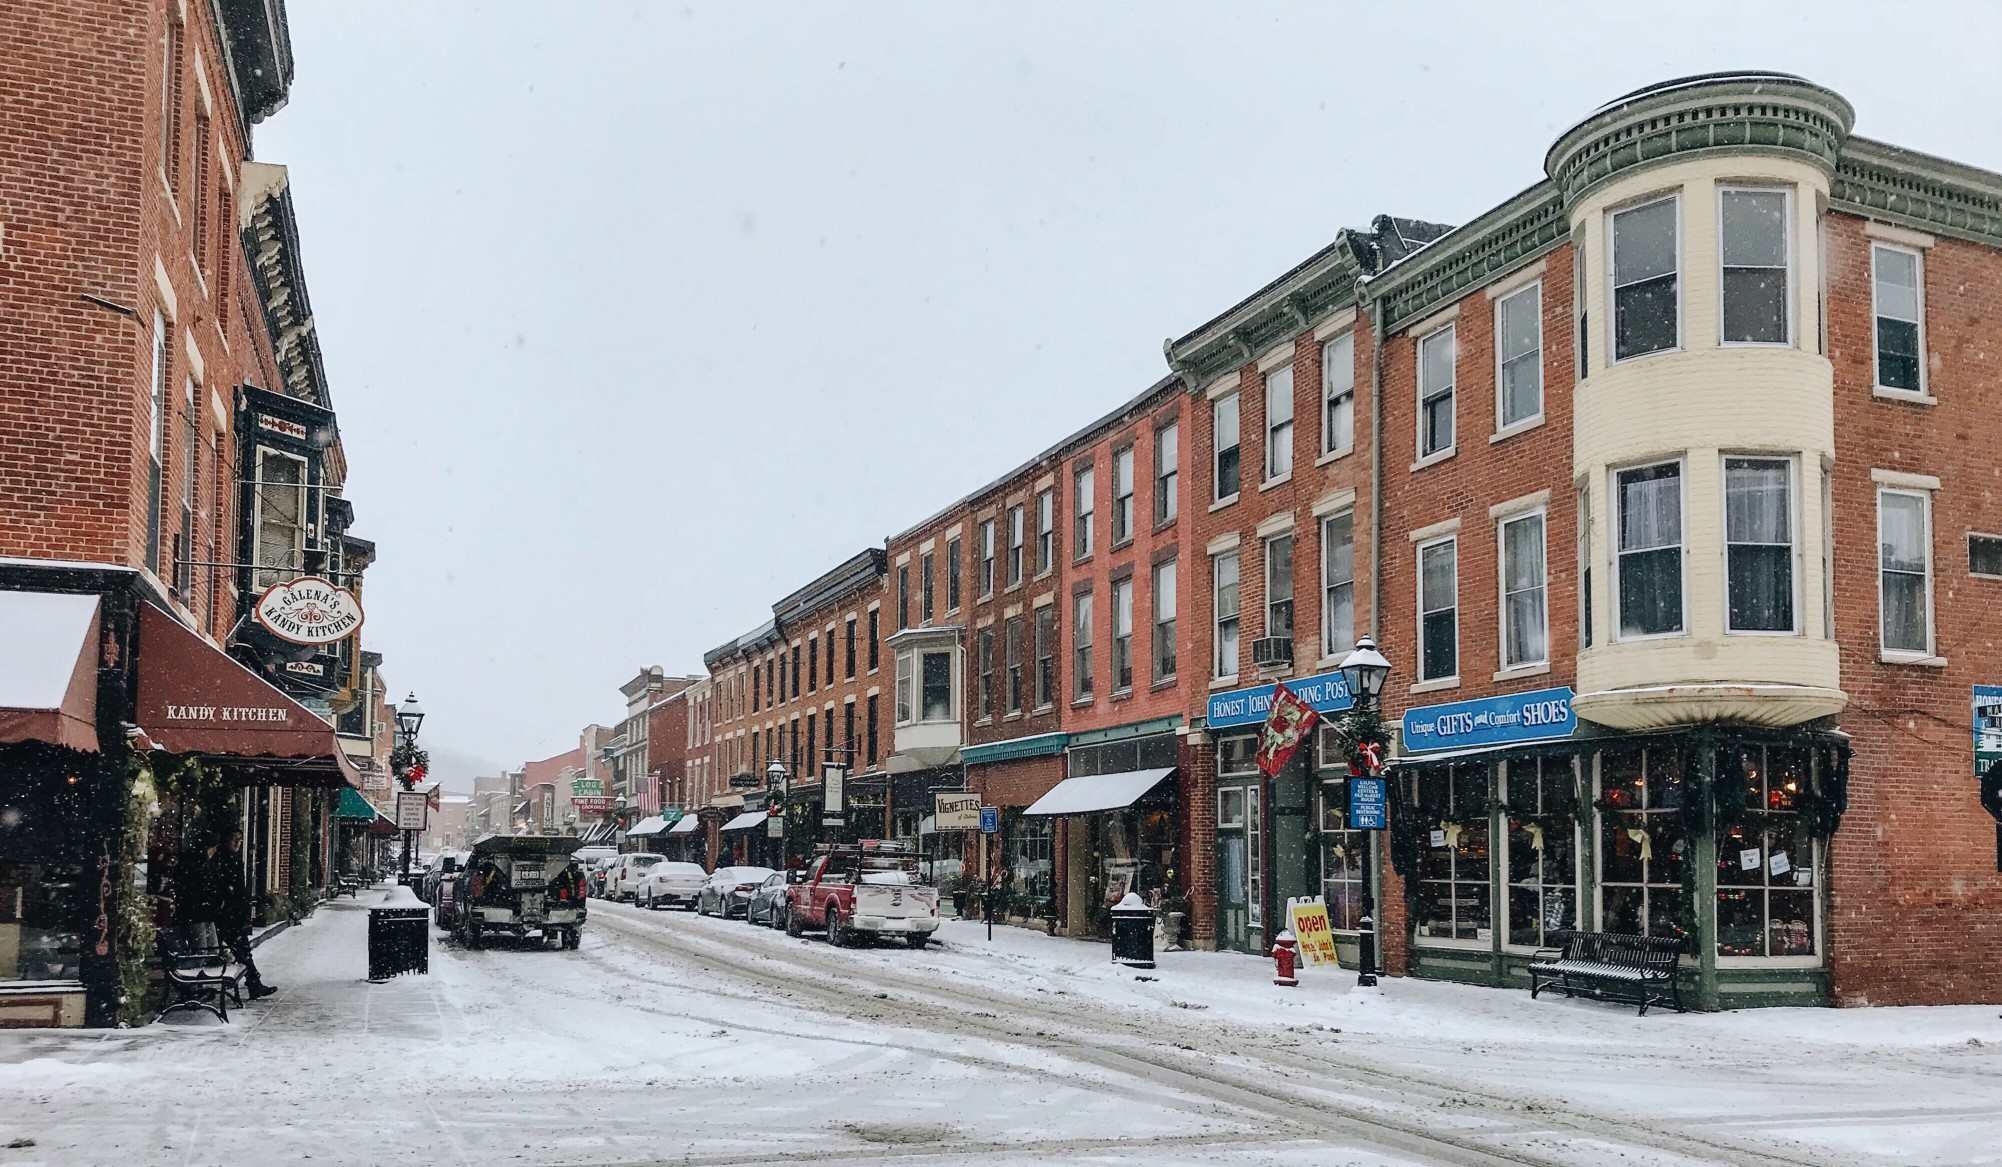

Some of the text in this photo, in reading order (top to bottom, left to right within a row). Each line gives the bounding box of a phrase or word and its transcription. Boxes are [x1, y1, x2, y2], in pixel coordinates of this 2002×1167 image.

[282, 588, 340, 610] GALENA'S
[265, 607, 357, 637] KANDY KITCHEN
[1213, 698, 1245, 718] HONEST
[1248, 693, 1275, 717] JOHN'
[1325, 680, 1350, 701] POST
[167, 705, 288, 721] KANDY KITCHEN
[1410, 699, 1568, 737] Unique GIFTS and Comfort SHOES
[937, 797, 980, 813] VIGNETTES
[1297, 914, 1327, 938] open
